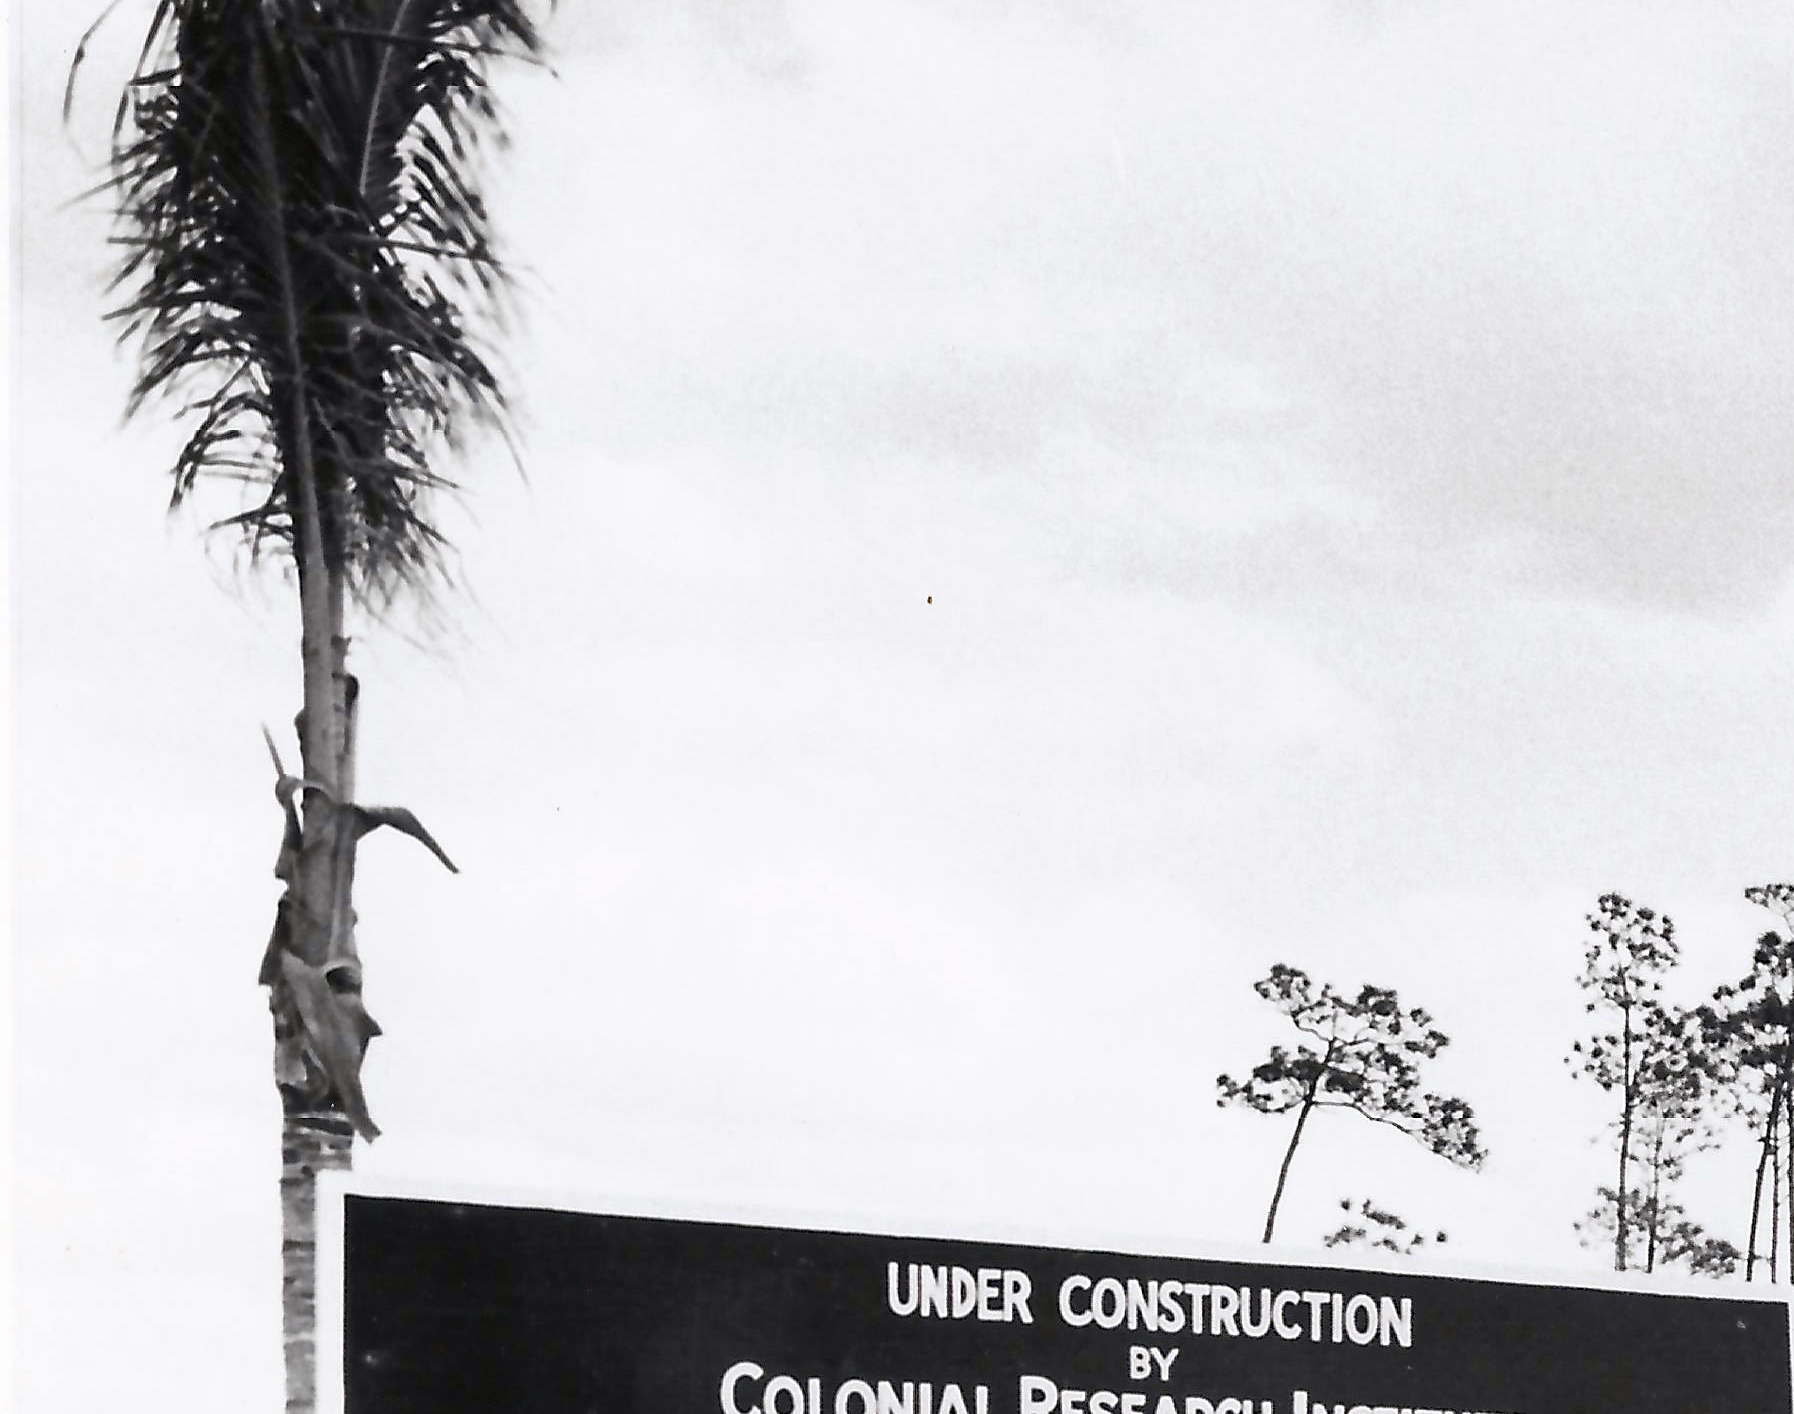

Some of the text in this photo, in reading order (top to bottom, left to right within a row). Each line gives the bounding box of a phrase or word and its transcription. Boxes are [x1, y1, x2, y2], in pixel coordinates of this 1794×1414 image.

[887, 1261, 1413, 1349] UNDER CONSTRUCTION
[1129, 1345, 1180, 1382] BY
